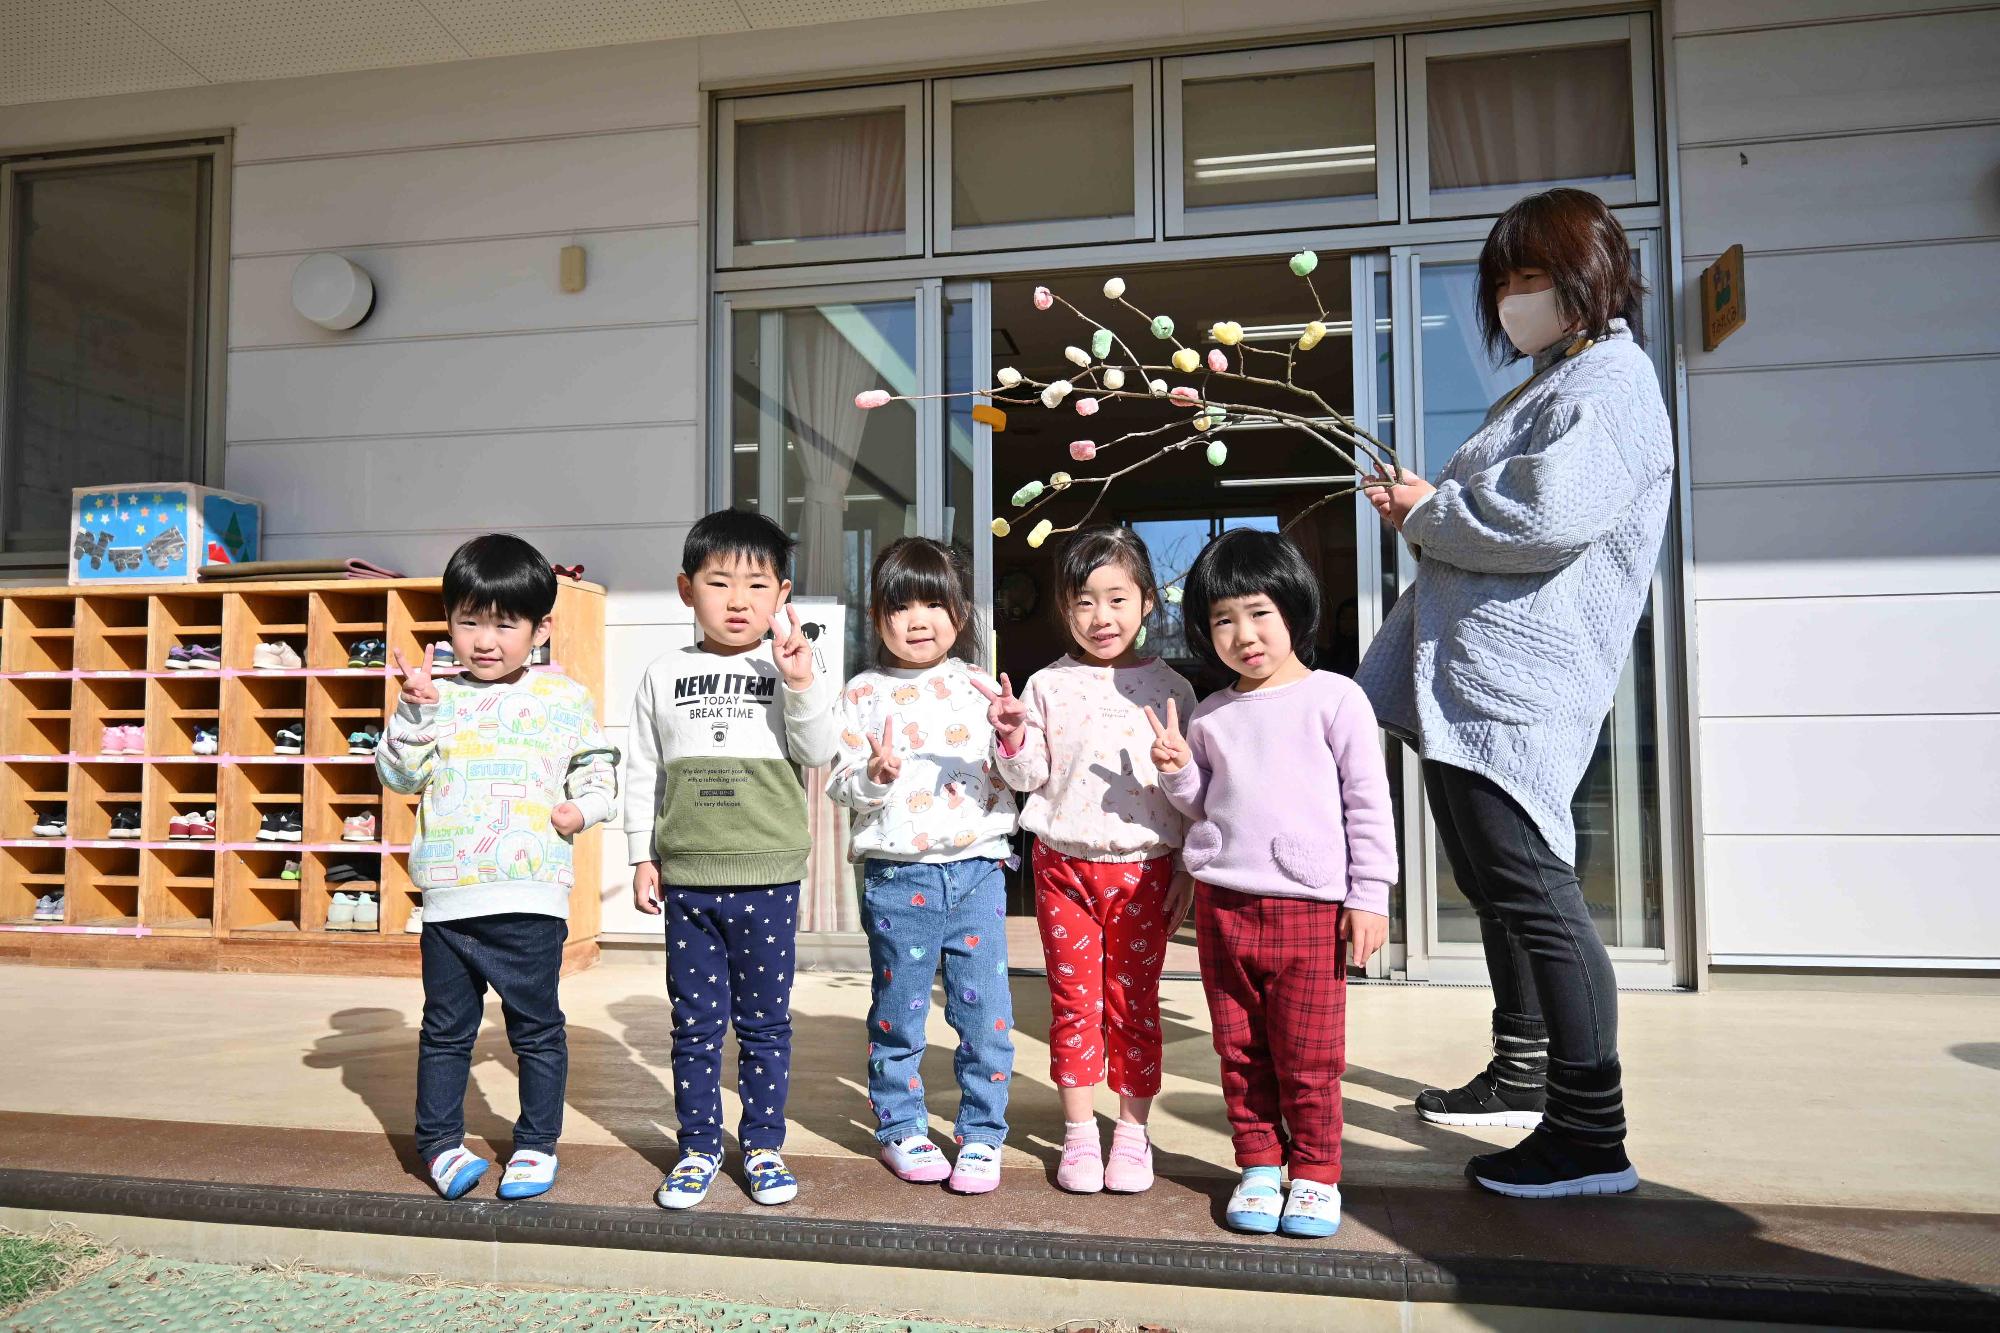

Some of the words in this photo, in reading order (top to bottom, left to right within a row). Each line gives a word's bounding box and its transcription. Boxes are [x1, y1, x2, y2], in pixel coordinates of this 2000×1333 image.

[674, 673, 721, 700] NEW
[723, 673, 777, 697] ITEM
[703, 696, 740, 705] TODAY
[689, 707, 723, 720] BREAK
[727, 707, 754, 719] TIME
[497, 736, 519, 746] PLAY
[469, 763, 522, 777] STURDY
